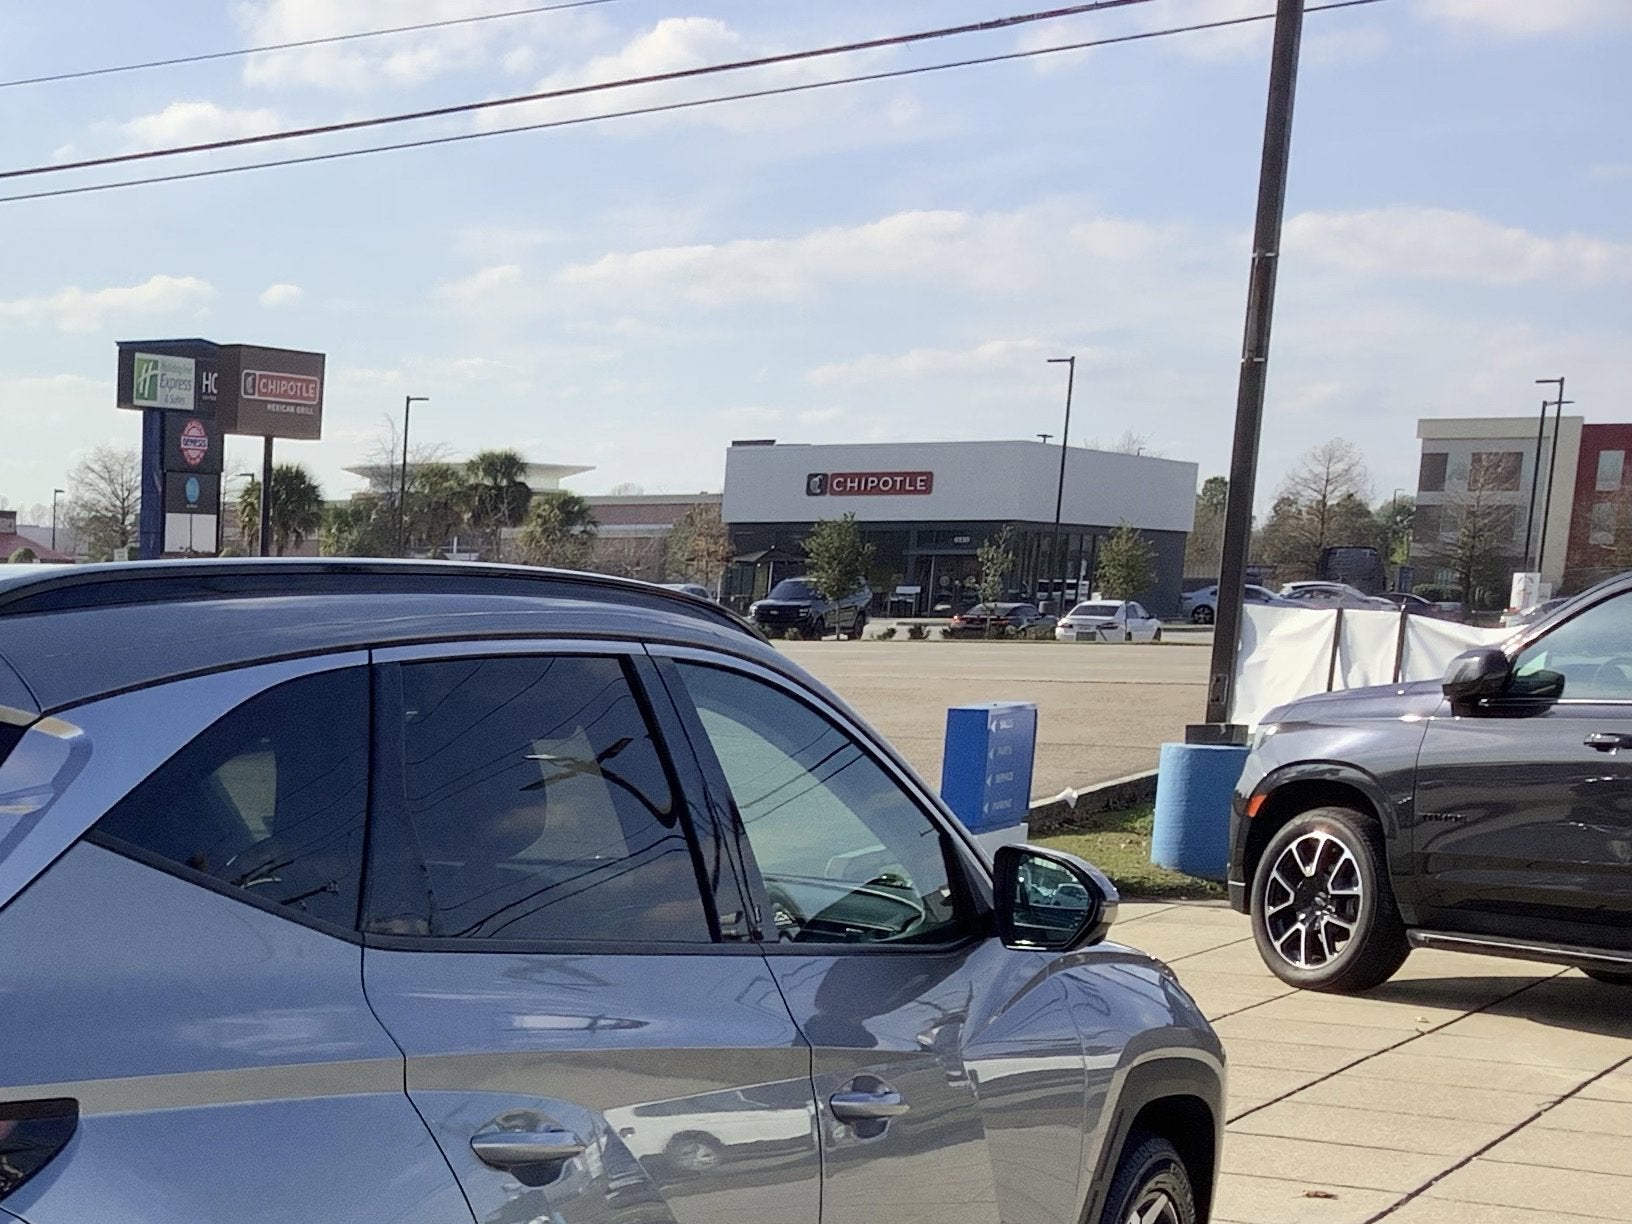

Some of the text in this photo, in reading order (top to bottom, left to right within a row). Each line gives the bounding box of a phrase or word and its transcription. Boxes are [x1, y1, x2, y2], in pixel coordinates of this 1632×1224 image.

[159, 373, 192, 394] Express
[259, 377, 316, 398] CHIPOTLE
[266, 403, 295, 413] MEXICAN
[832, 475, 928, 492] CHIPOTLE
